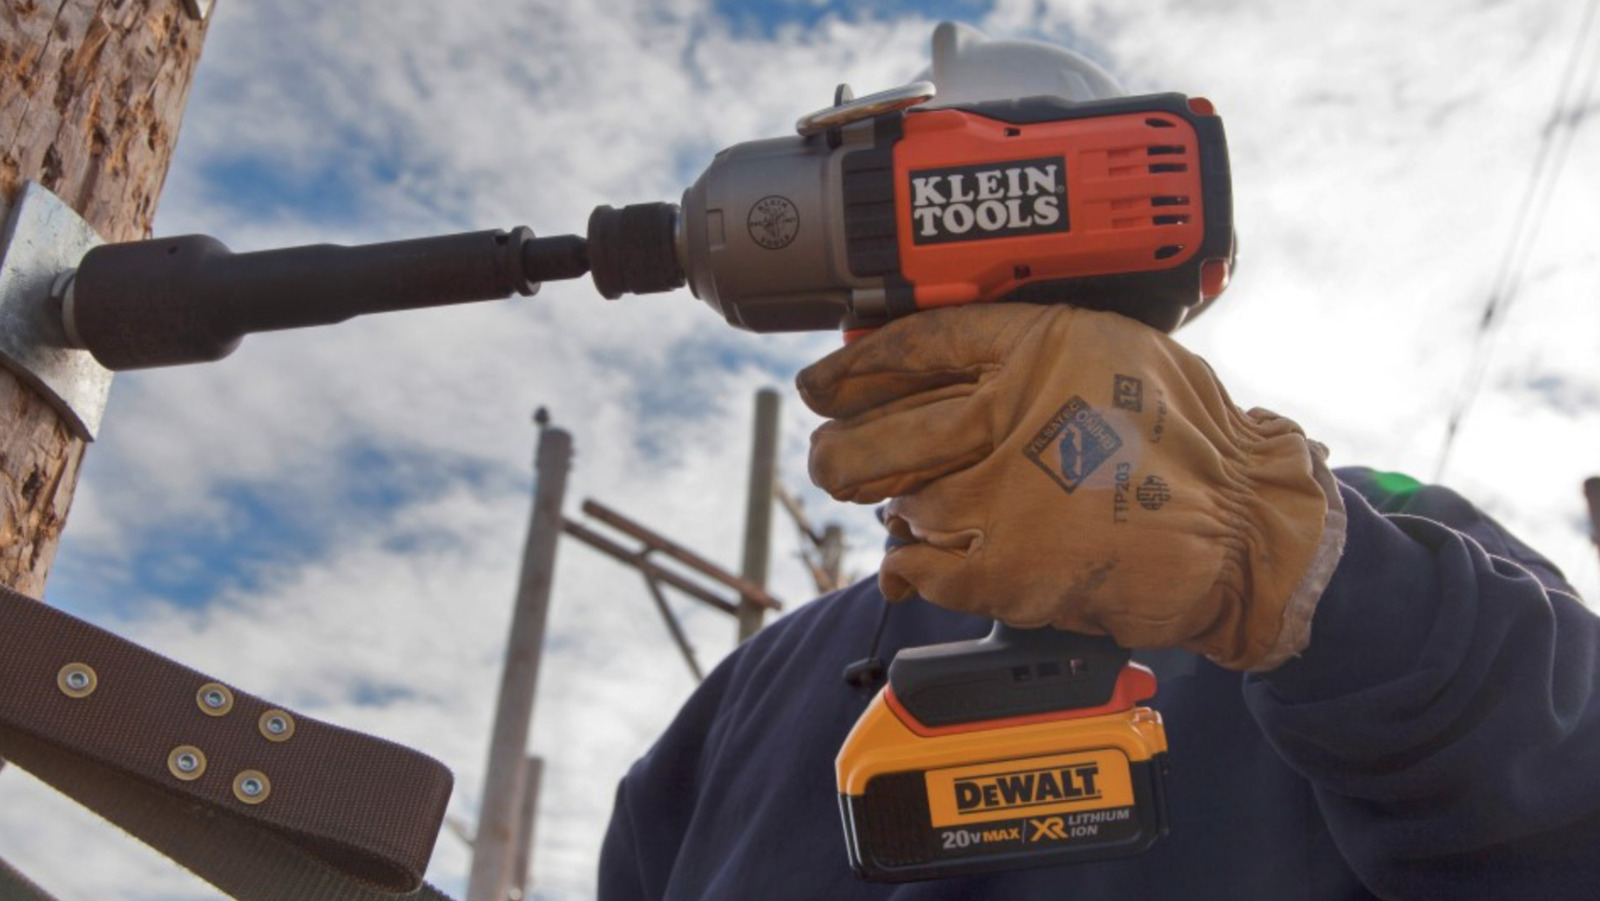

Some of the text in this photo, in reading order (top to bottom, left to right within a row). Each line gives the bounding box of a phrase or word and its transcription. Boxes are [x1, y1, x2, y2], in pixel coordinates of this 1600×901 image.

[912, 164, 1058, 207] KLEIN
[913, 195, 1060, 236] TOOLS
[1120, 381, 1138, 409] 12
[983, 827, 1020, 842] MAX
[1029, 816, 1068, 841] XR
[1067, 809, 1129, 826] LITHIUM
[1070, 824, 1098, 837] ION
